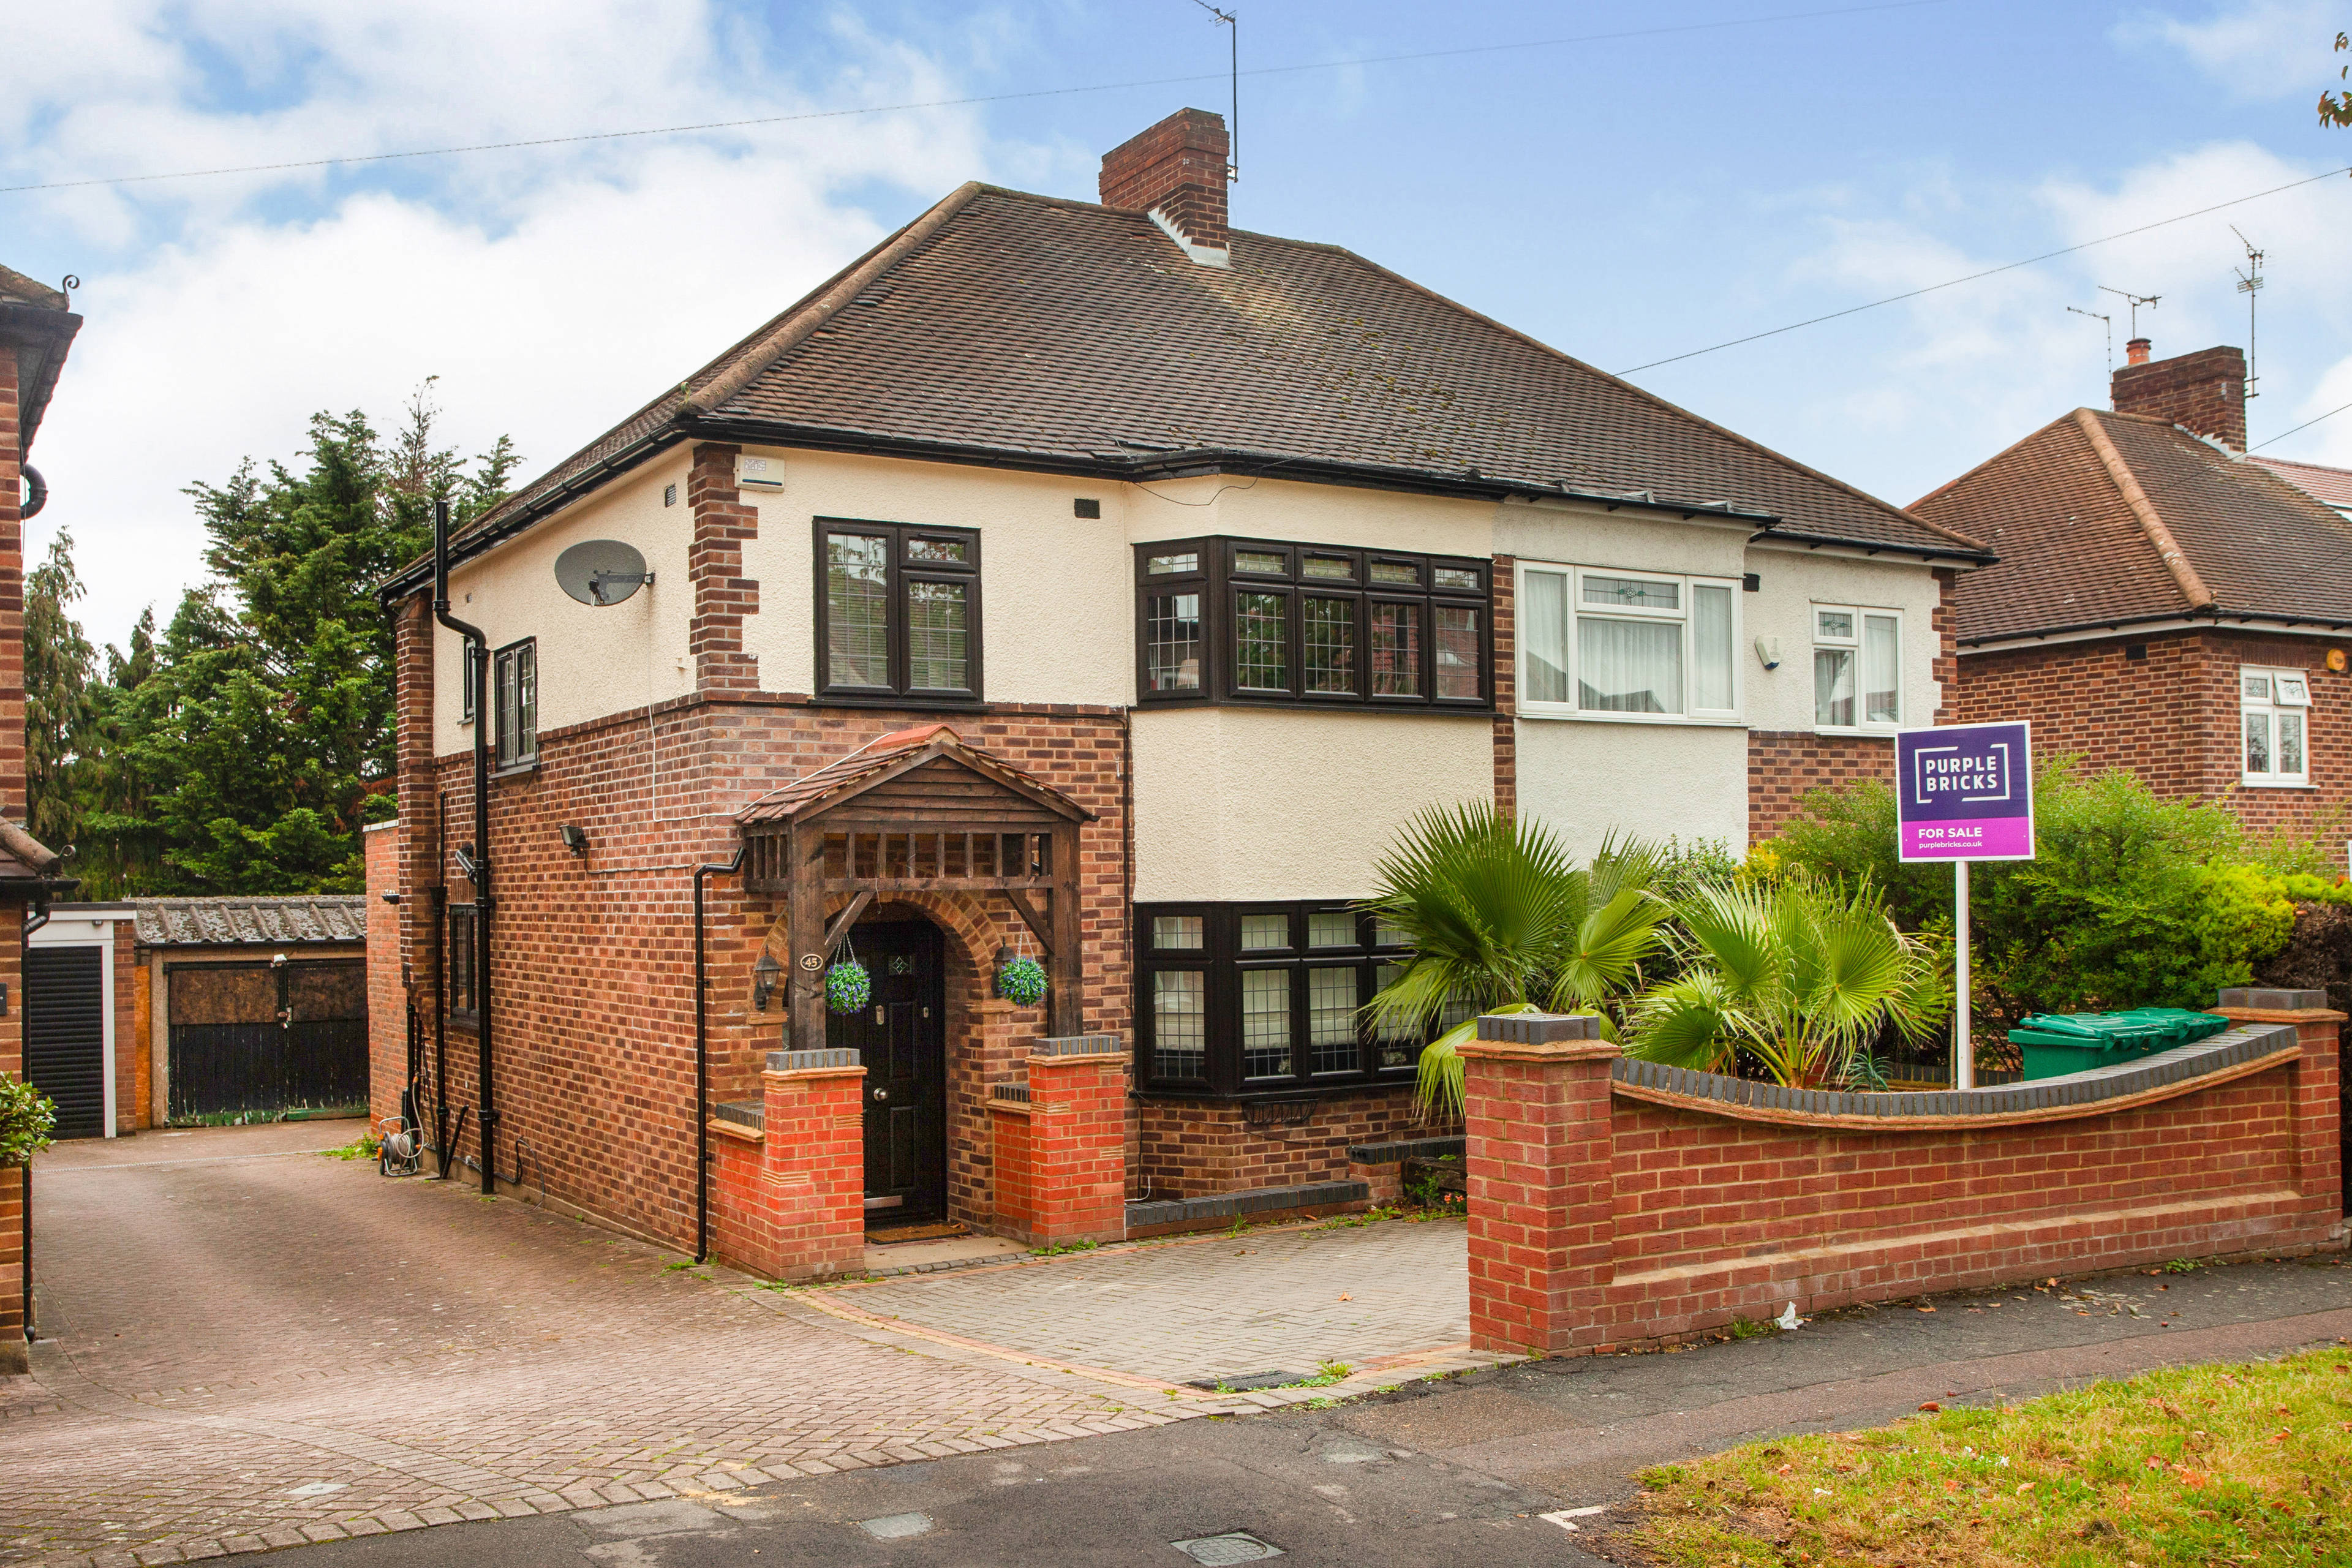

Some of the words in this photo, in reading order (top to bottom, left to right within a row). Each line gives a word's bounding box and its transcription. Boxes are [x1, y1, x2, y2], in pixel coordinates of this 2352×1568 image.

[1926, 756, 1997, 774] PURPLE
[1926, 774, 1997, 791] BRICKS
[1918, 828, 1944, 839] FOR
[1948, 827, 1983, 838] SALE
[1918, 840, 1983, 850] purplebricks.co.uk
[805, 957, 818, 967] 45
